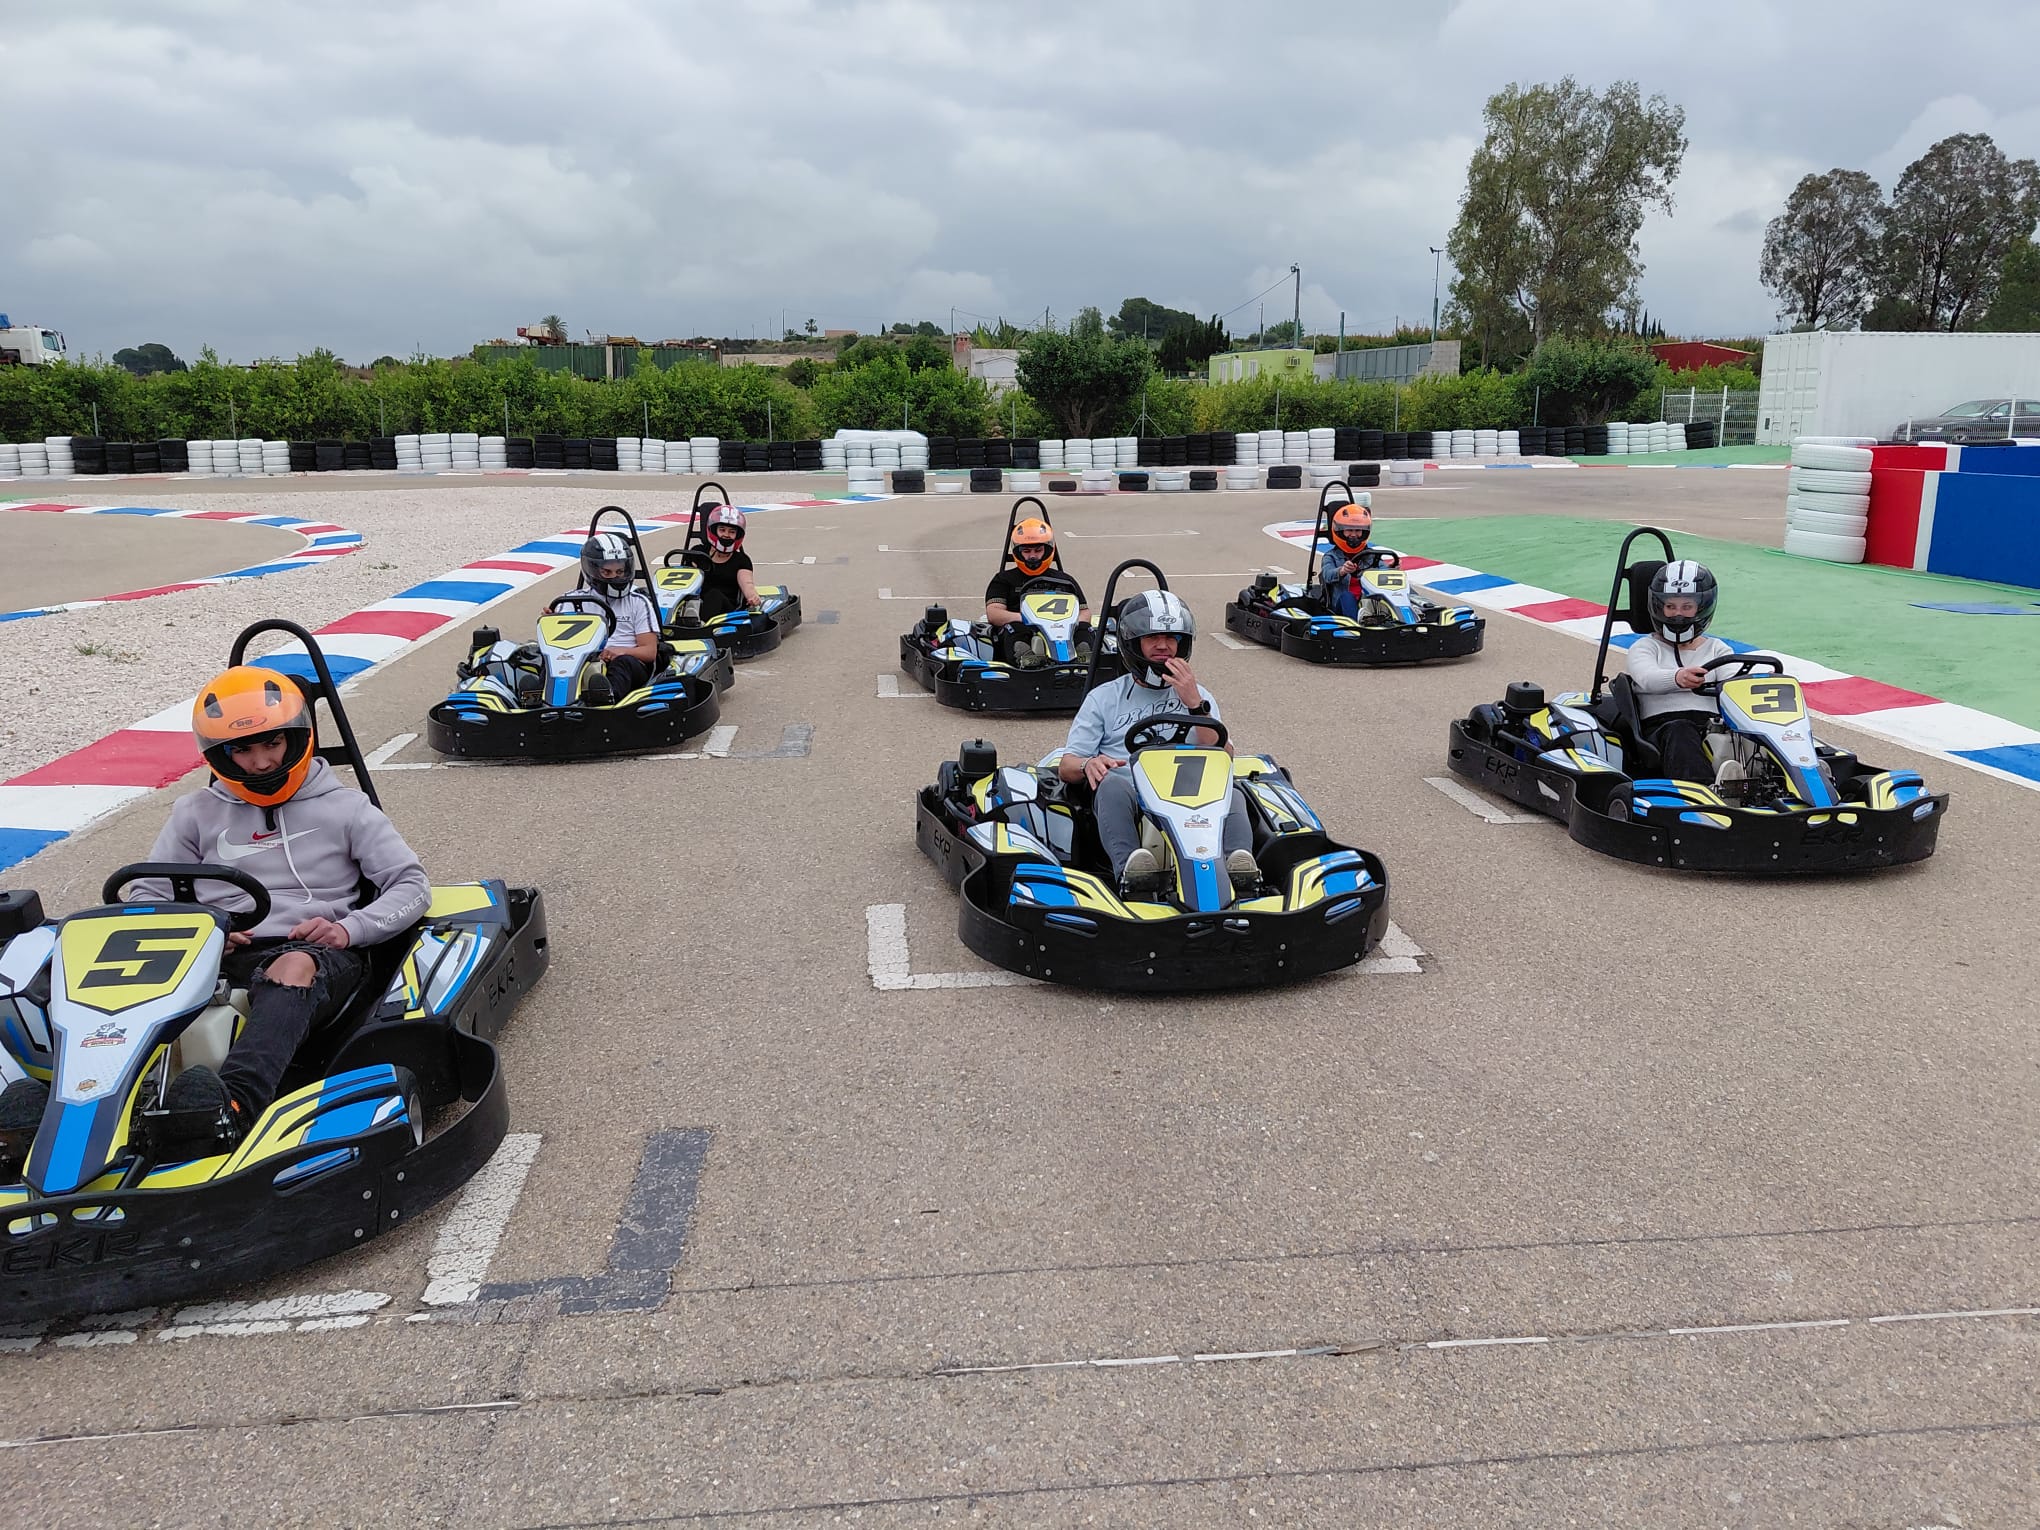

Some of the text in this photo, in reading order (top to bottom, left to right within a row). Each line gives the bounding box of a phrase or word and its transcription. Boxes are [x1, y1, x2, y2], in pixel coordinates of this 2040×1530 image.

[661, 572, 694, 586] 2
[1377, 574, 1403, 586] 6
[1037, 599, 1069, 614] 4
[551, 620, 593, 641] 7
[1750, 683, 1798, 714] 3
[1171, 755, 1207, 797] 1
[1486, 756, 1518, 784] EKR
[77, 926, 201, 989] 5
[2, 1231, 142, 1275] EKR
